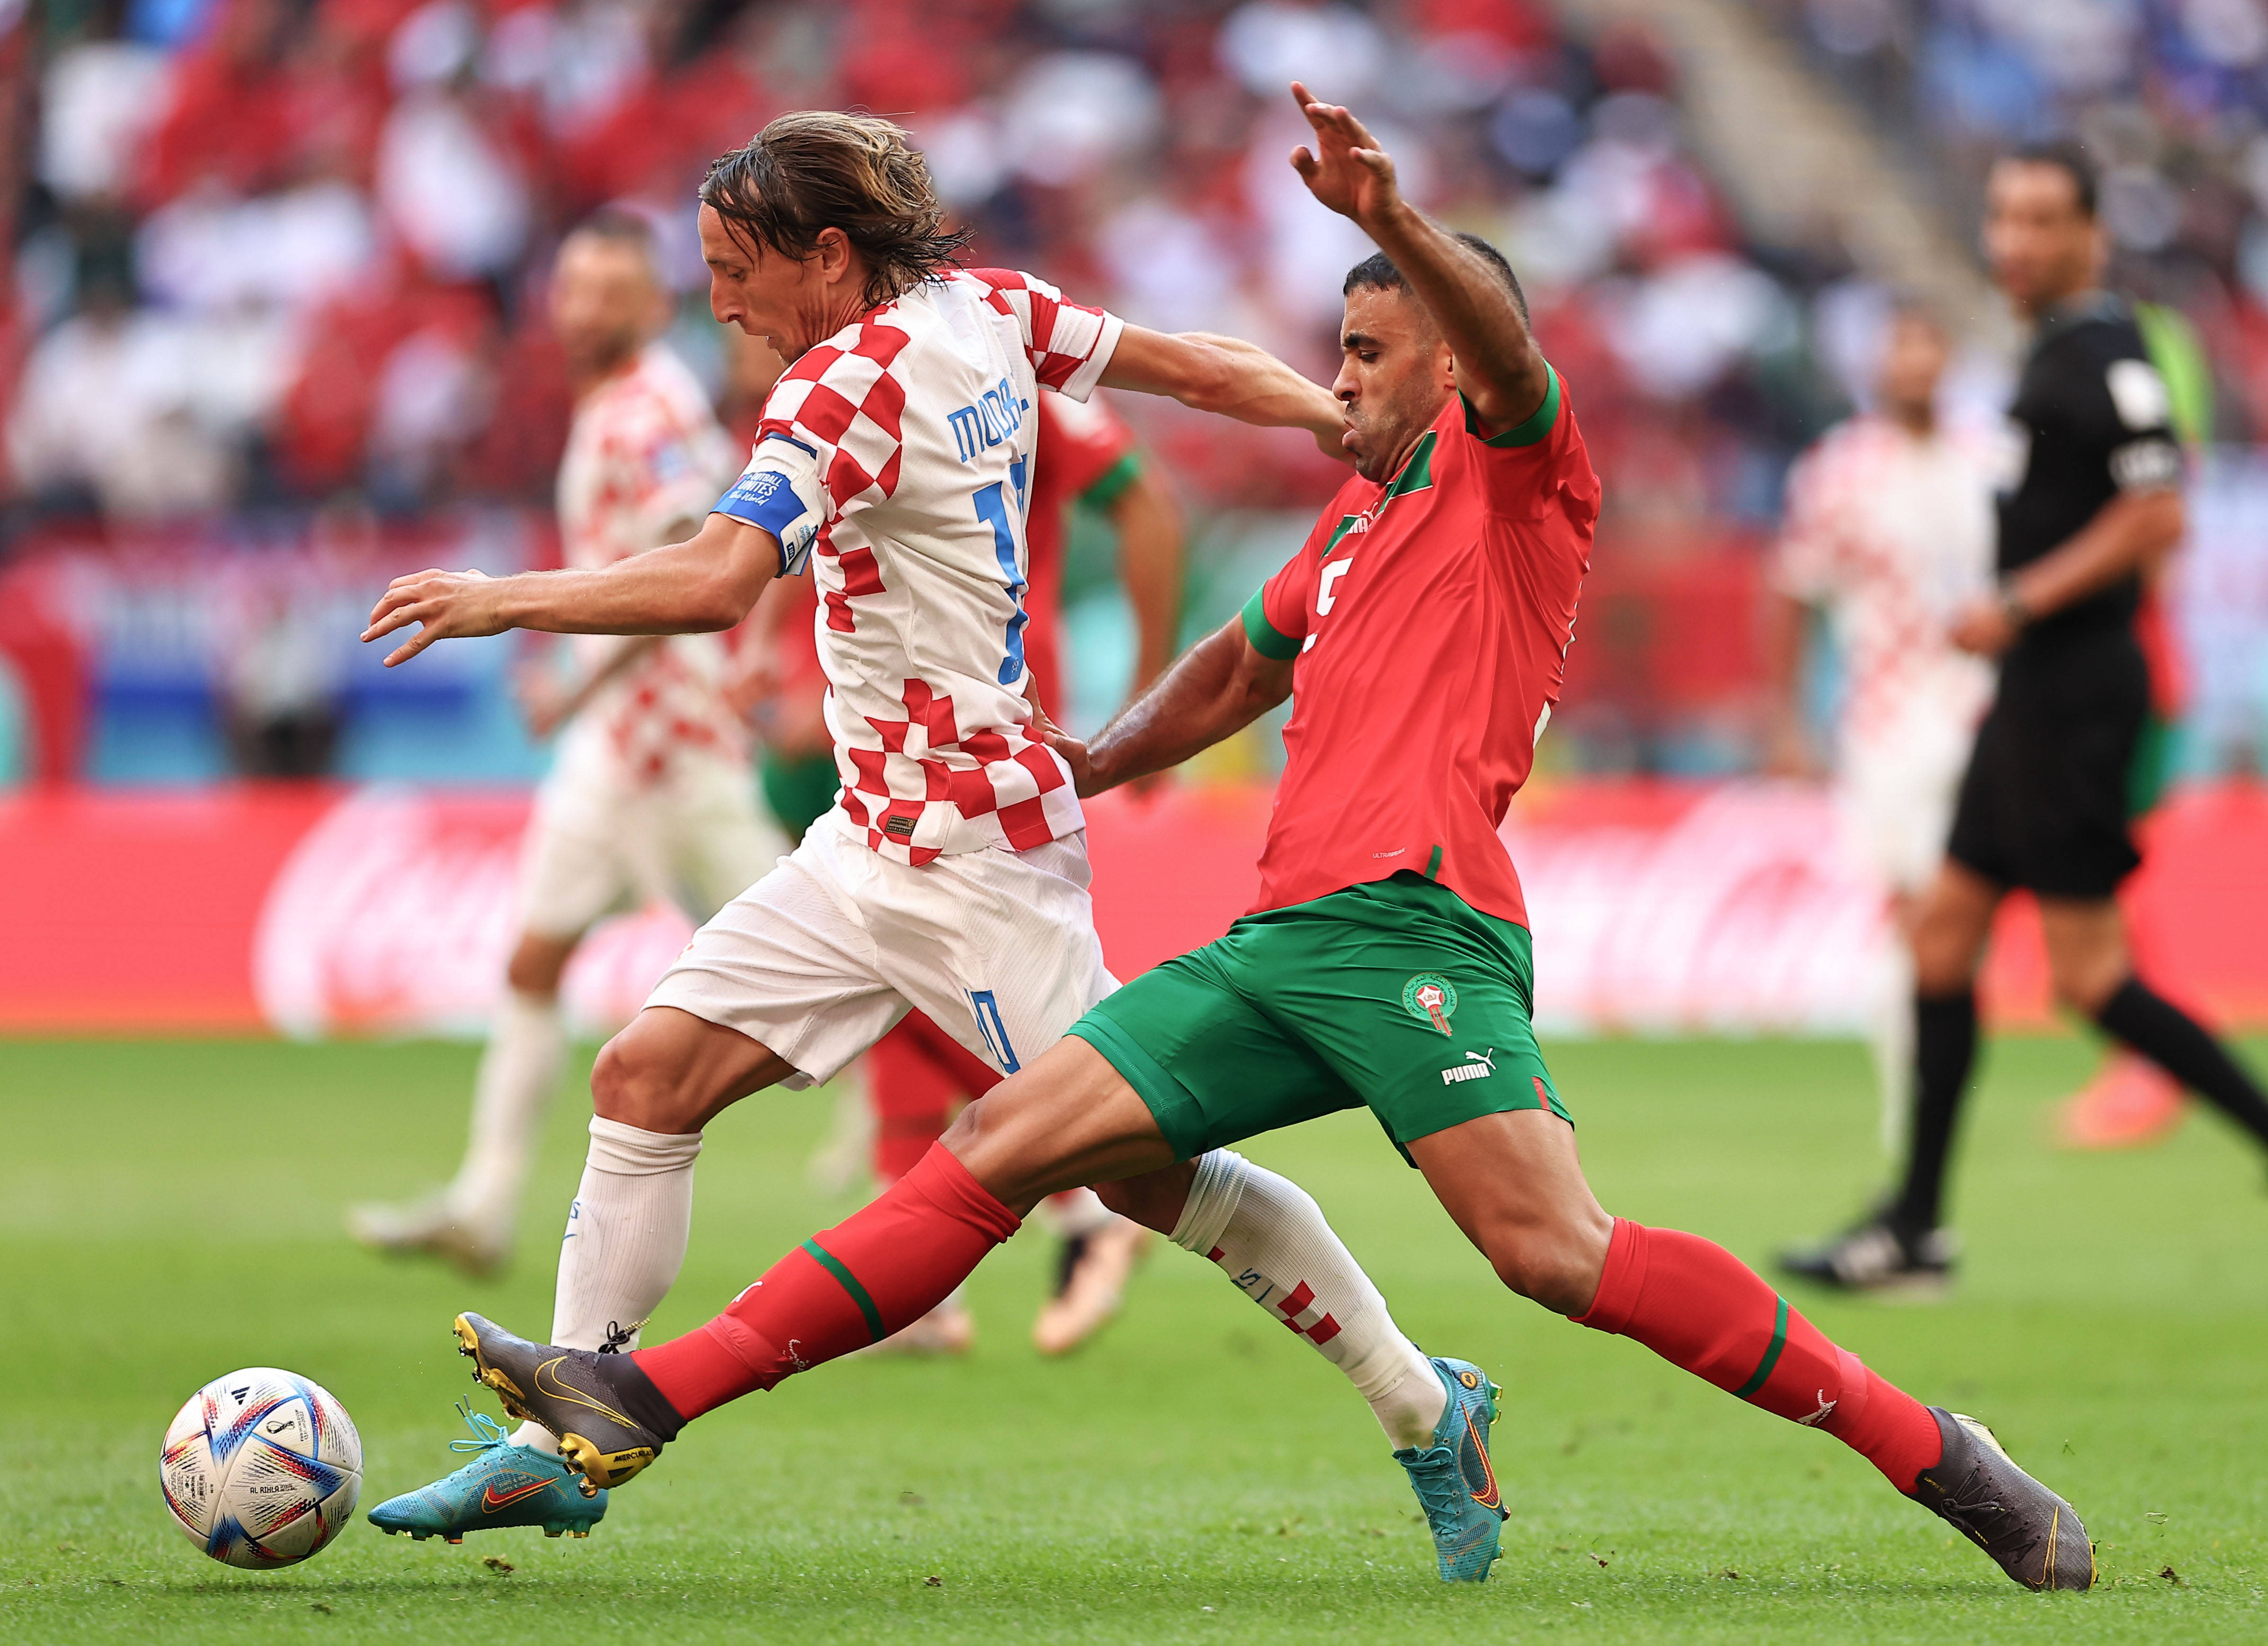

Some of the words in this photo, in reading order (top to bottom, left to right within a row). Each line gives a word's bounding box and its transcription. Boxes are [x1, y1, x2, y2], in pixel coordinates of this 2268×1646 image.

[947, 377, 1029, 463] MODR
[738, 480, 778, 497] UNITES
[747, 473, 783, 487] FOOTBALL
[740, 492, 770, 507] World
[972, 453, 1028, 685] 1
[963, 987, 1021, 1075] 0
[1441, 1062, 1491, 1086] PUMA
[260, 1486, 279, 1494] RIHLA
